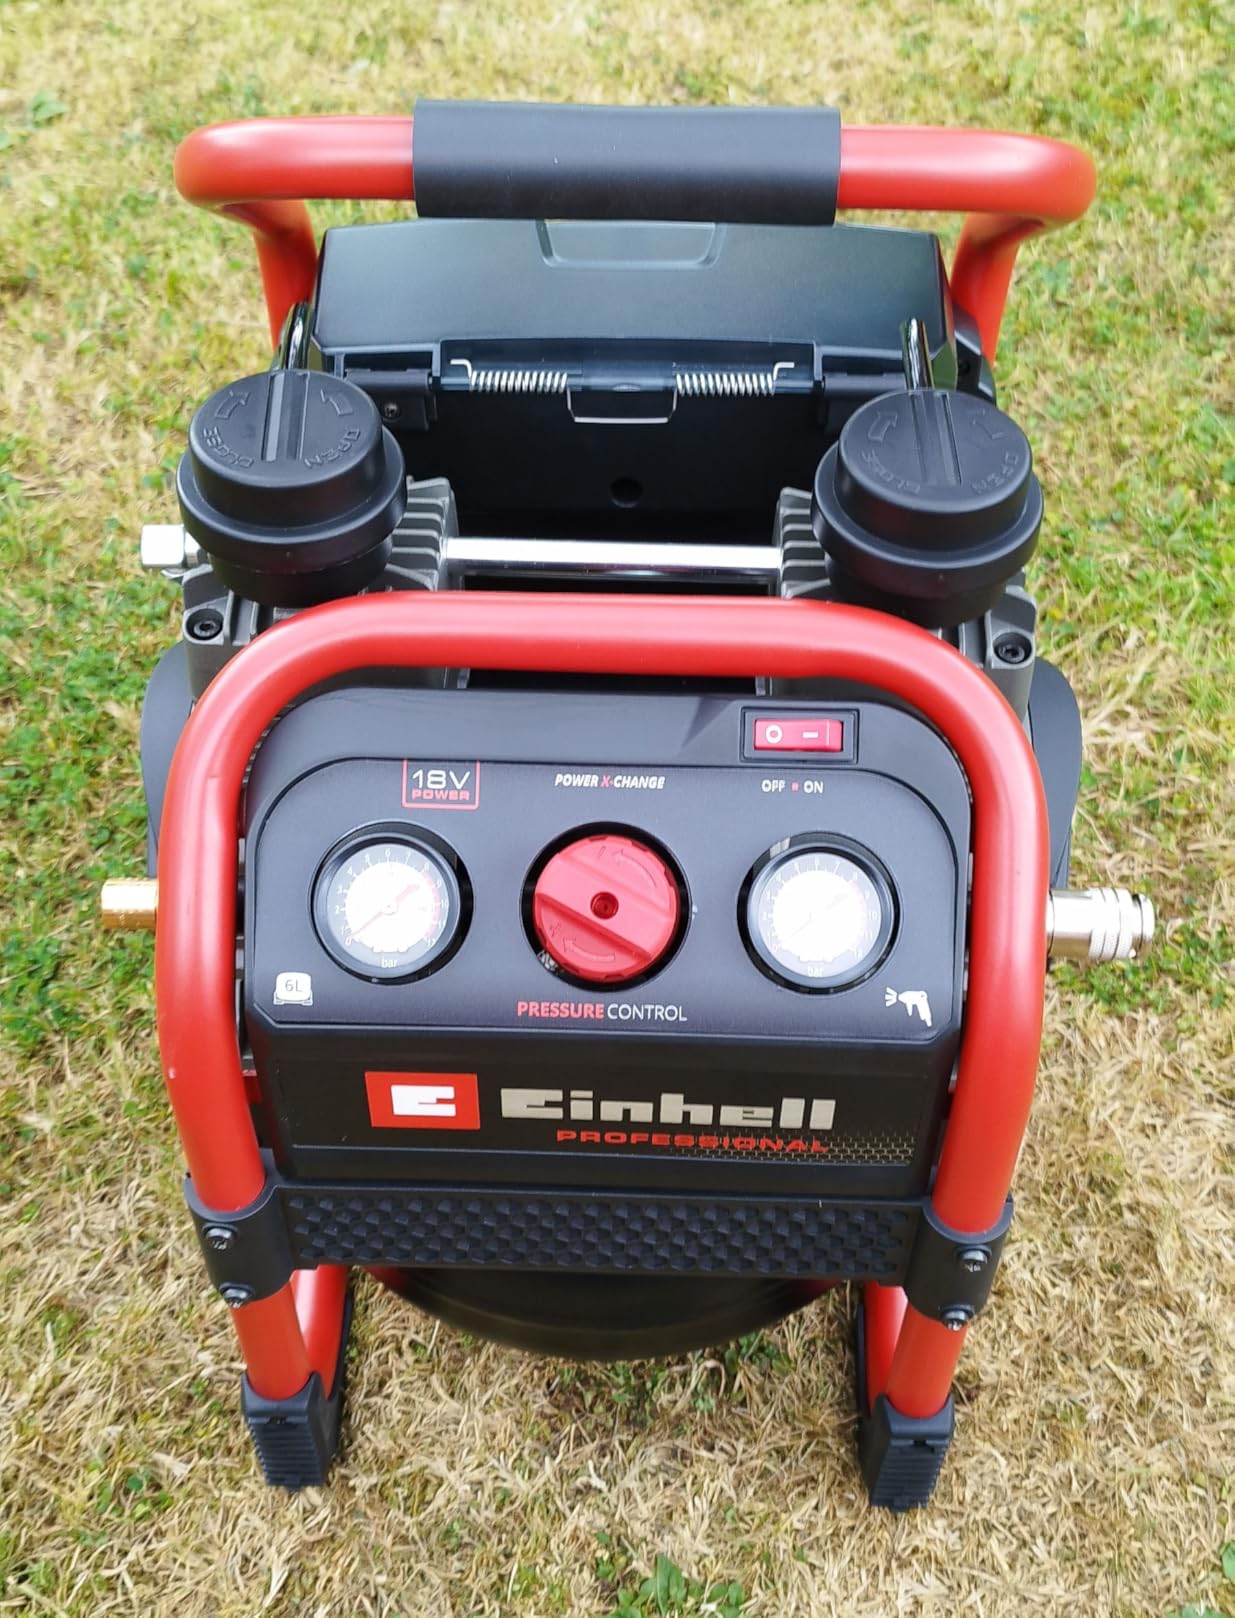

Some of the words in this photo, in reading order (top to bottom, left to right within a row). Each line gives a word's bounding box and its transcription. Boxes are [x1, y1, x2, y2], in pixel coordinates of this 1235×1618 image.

[304, 428, 361, 469] OPEN
[412, 769, 471, 789] 18V
[554, 773, 599, 788] POWER
[761, 779, 786, 793] OFF
[803, 780, 824, 794] ON
[411, 788, 470, 801] POWER
[381, 958, 398, 969] bar
[285, 979, 304, 992] 6L
[517, 1001, 604, 1019] PRESSURE
[607, 1003, 688, 1022] CONTROL
[556, 1129, 829, 1153] PROFESSIONAL
